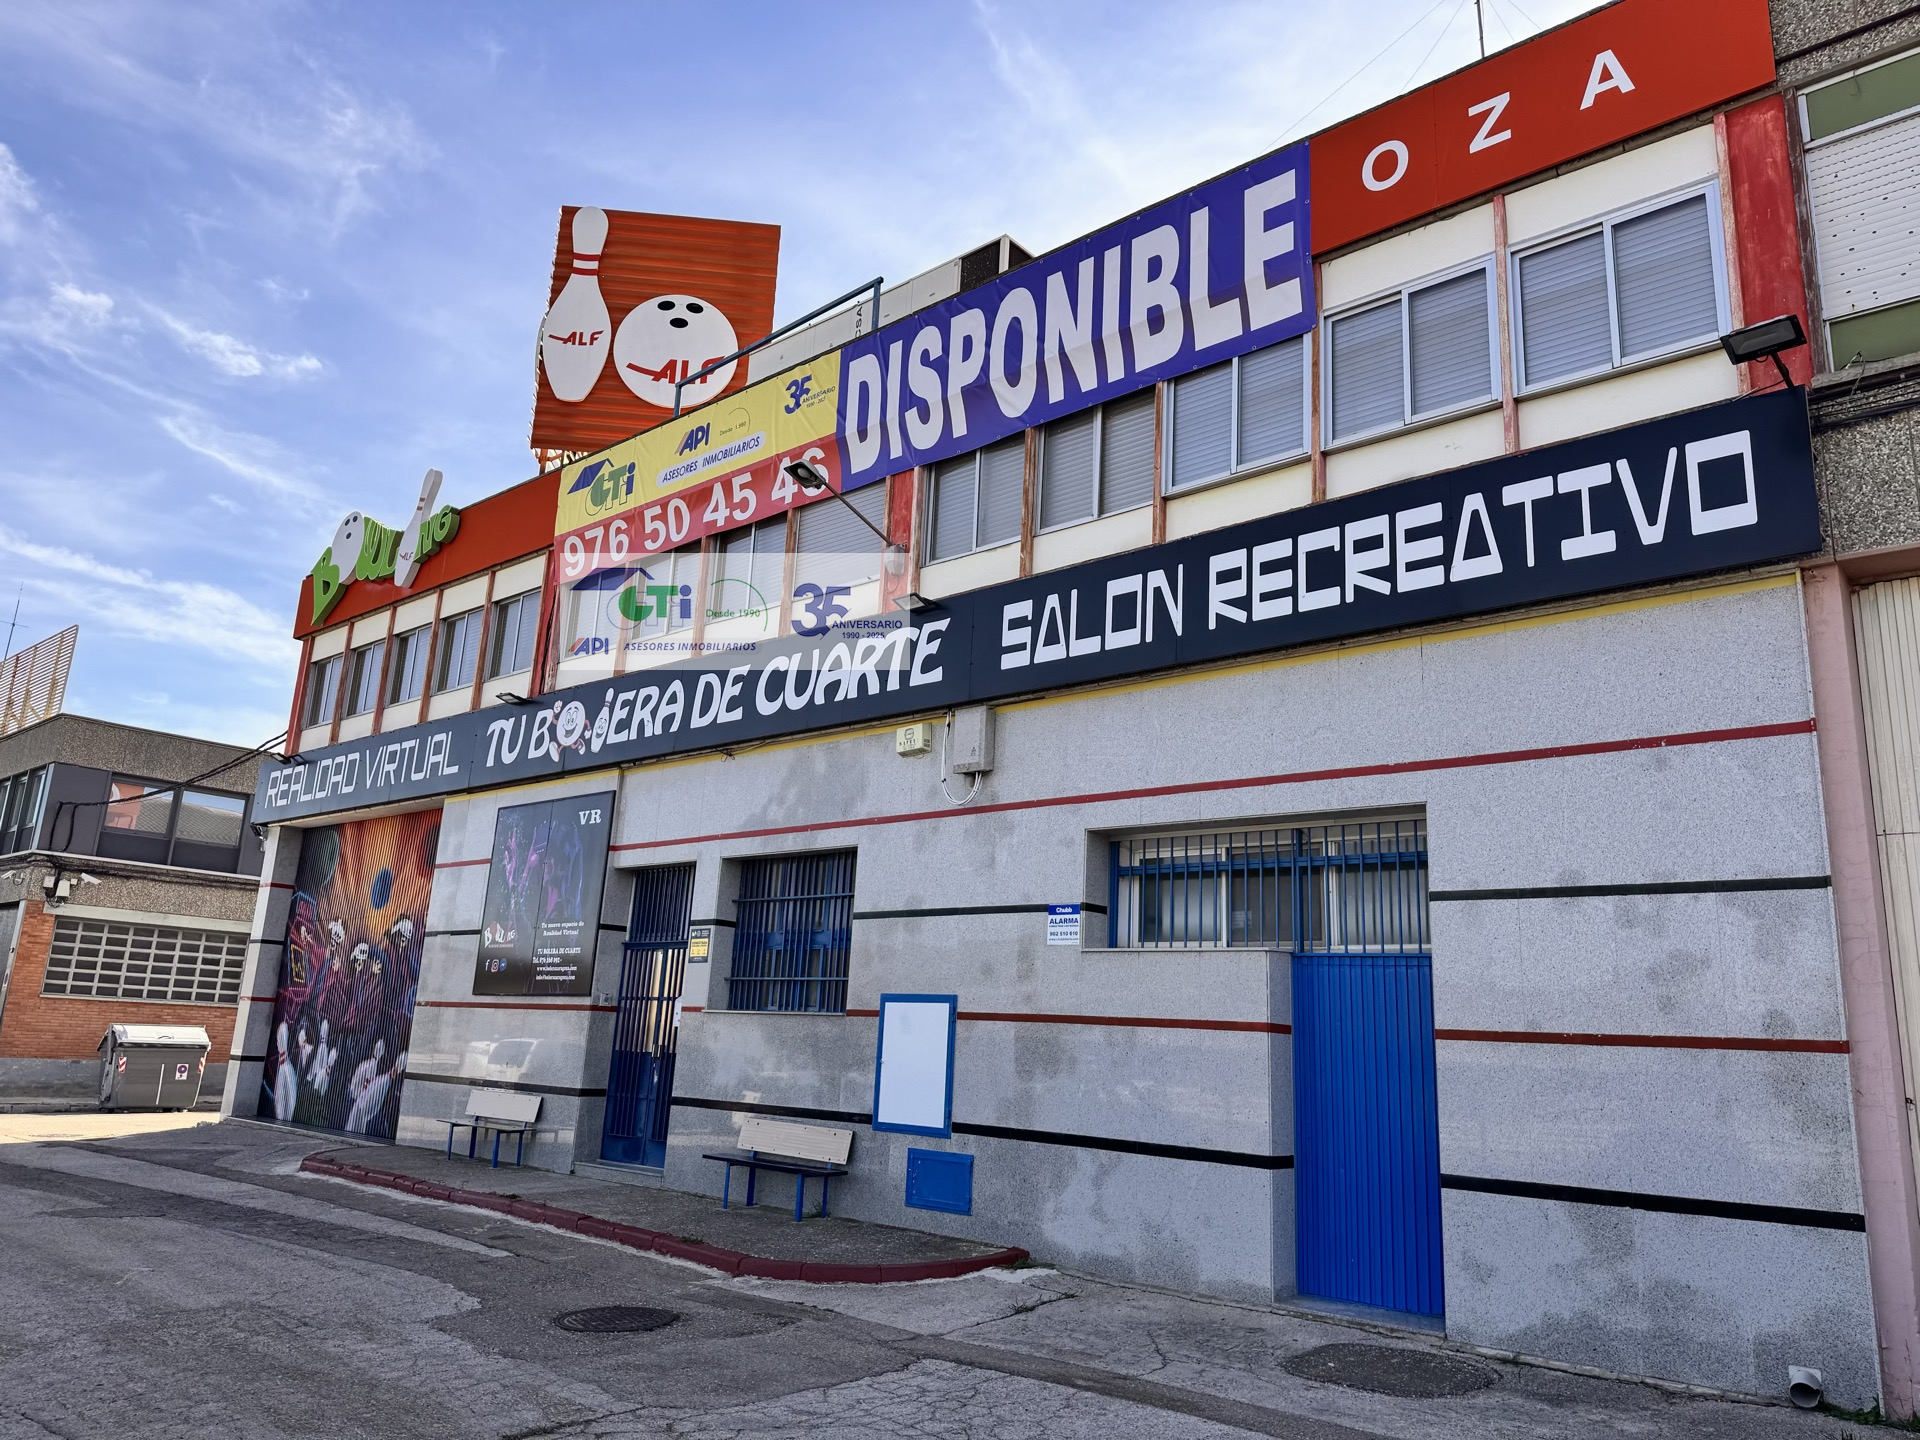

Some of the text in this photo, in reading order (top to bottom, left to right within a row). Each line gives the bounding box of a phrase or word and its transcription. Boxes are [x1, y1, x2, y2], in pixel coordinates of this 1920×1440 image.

[551, 330, 604, 346] ALF
[845, 168, 1303, 475] DISPONIBLE
[627, 356, 726, 384] ALF
[784, 374, 813, 415] 35
[802, 386, 836, 404] ANIVERSARIO
[662, 436, 761, 483] ASESORES INMOBILIARIOS
[676, 422, 711, 456] API
[563, 447, 829, 577] 976 50 45 46
[1000, 429, 1759, 671] SALON RECREATIVO
[486, 714, 526, 768] TU
[690, 664, 750, 729] DE
[755, 618, 951, 716] CUARTE
[265, 731, 459, 808] REALIDAD VIRTUAL
[579, 809, 602, 825] VR
[1049, 917, 1079, 925] ALARMA
